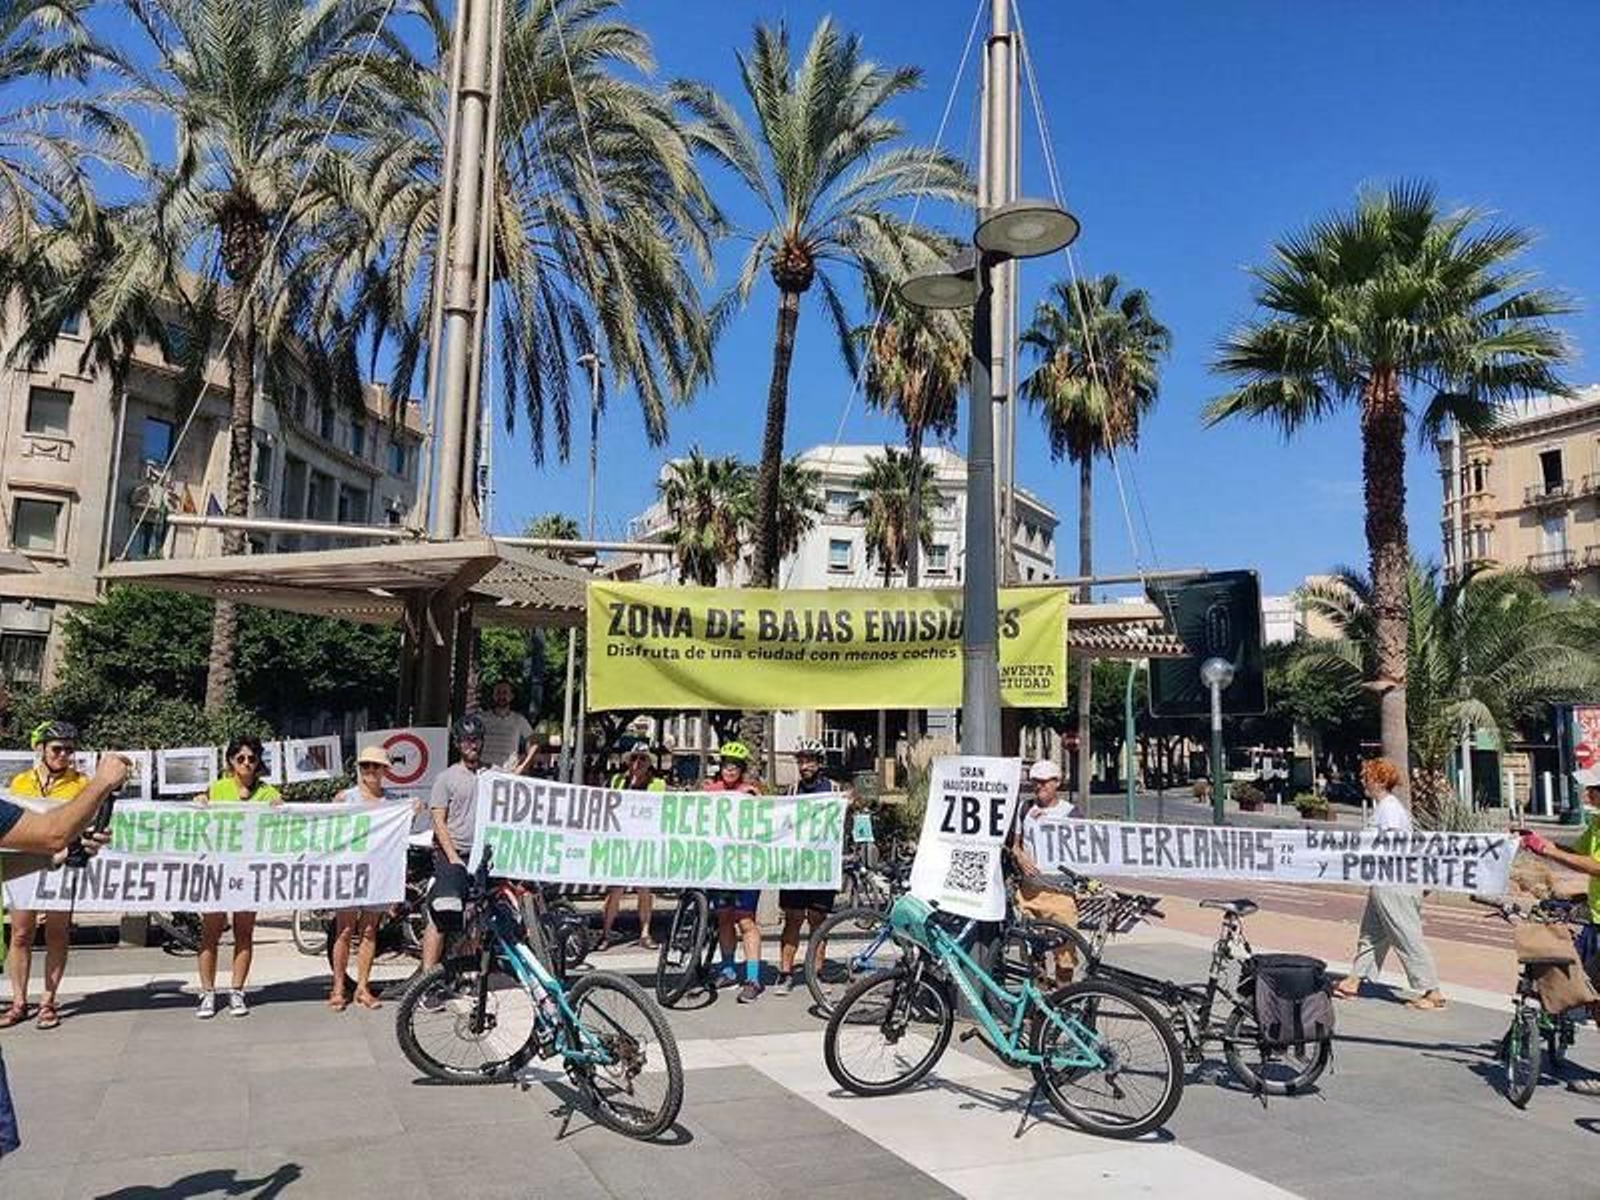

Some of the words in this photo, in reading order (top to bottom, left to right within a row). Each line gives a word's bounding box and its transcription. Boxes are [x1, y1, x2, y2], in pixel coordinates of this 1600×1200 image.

[607, 603, 693, 638] ZONA
[705, 608, 745, 640] DE
[758, 609, 854, 643] BAJAS
[865, 607, 1020, 642] EMISIOS
[607, 643, 680, 660] Disfruta
[685, 645, 705, 660] de
[711, 649, 742, 661] una
[747, 647, 804, 662] ciudad
[810, 650, 839, 661] con
[845, 648, 897, 661] menos
[903, 647, 957, 660] coches
[1001, 665, 1054, 677] NVENTA
[960, 767, 985, 778] GRAN
[490, 779, 622, 832] ADECUAR
[660, 794, 774, 843] ACERAS
[940, 795, 1006, 836] ZBE
[110, 811, 245, 853] NSPORTE
[1040, 824, 1110, 864] TREN
[1120, 826, 1275, 871] CERCANIAS
[1307, 829, 1362, 851] BAJO
[1371, 828, 1505, 862] ANDARAX
[229, 877, 244, 890] DE
[249, 855, 370, 901] TRÁFICO
[590, 838, 718, 880] MOVILIDAD
[721, 844, 833, 884] REDUCIDA
[1343, 855, 1479, 889] PONIENTE
